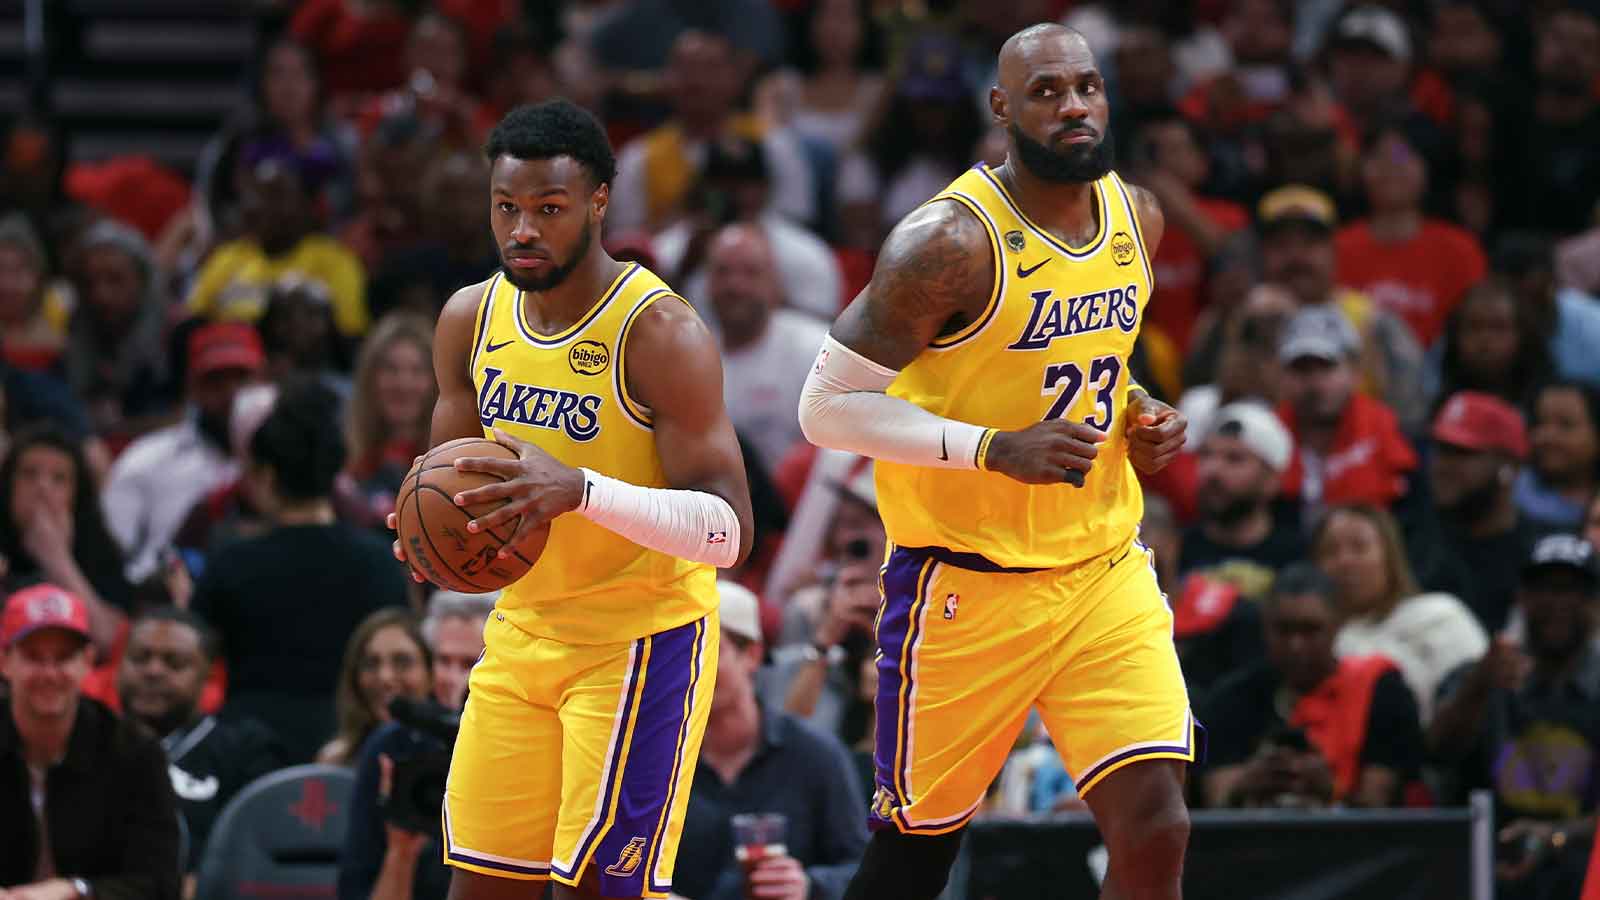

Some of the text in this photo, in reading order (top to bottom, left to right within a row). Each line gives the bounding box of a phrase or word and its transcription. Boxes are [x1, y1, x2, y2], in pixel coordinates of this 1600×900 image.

[1008, 285, 1138, 350] LAKERS
[573, 349, 607, 366] bibigo
[479, 367, 602, 442] LAKERS
[1042, 354, 1121, 432] 23
